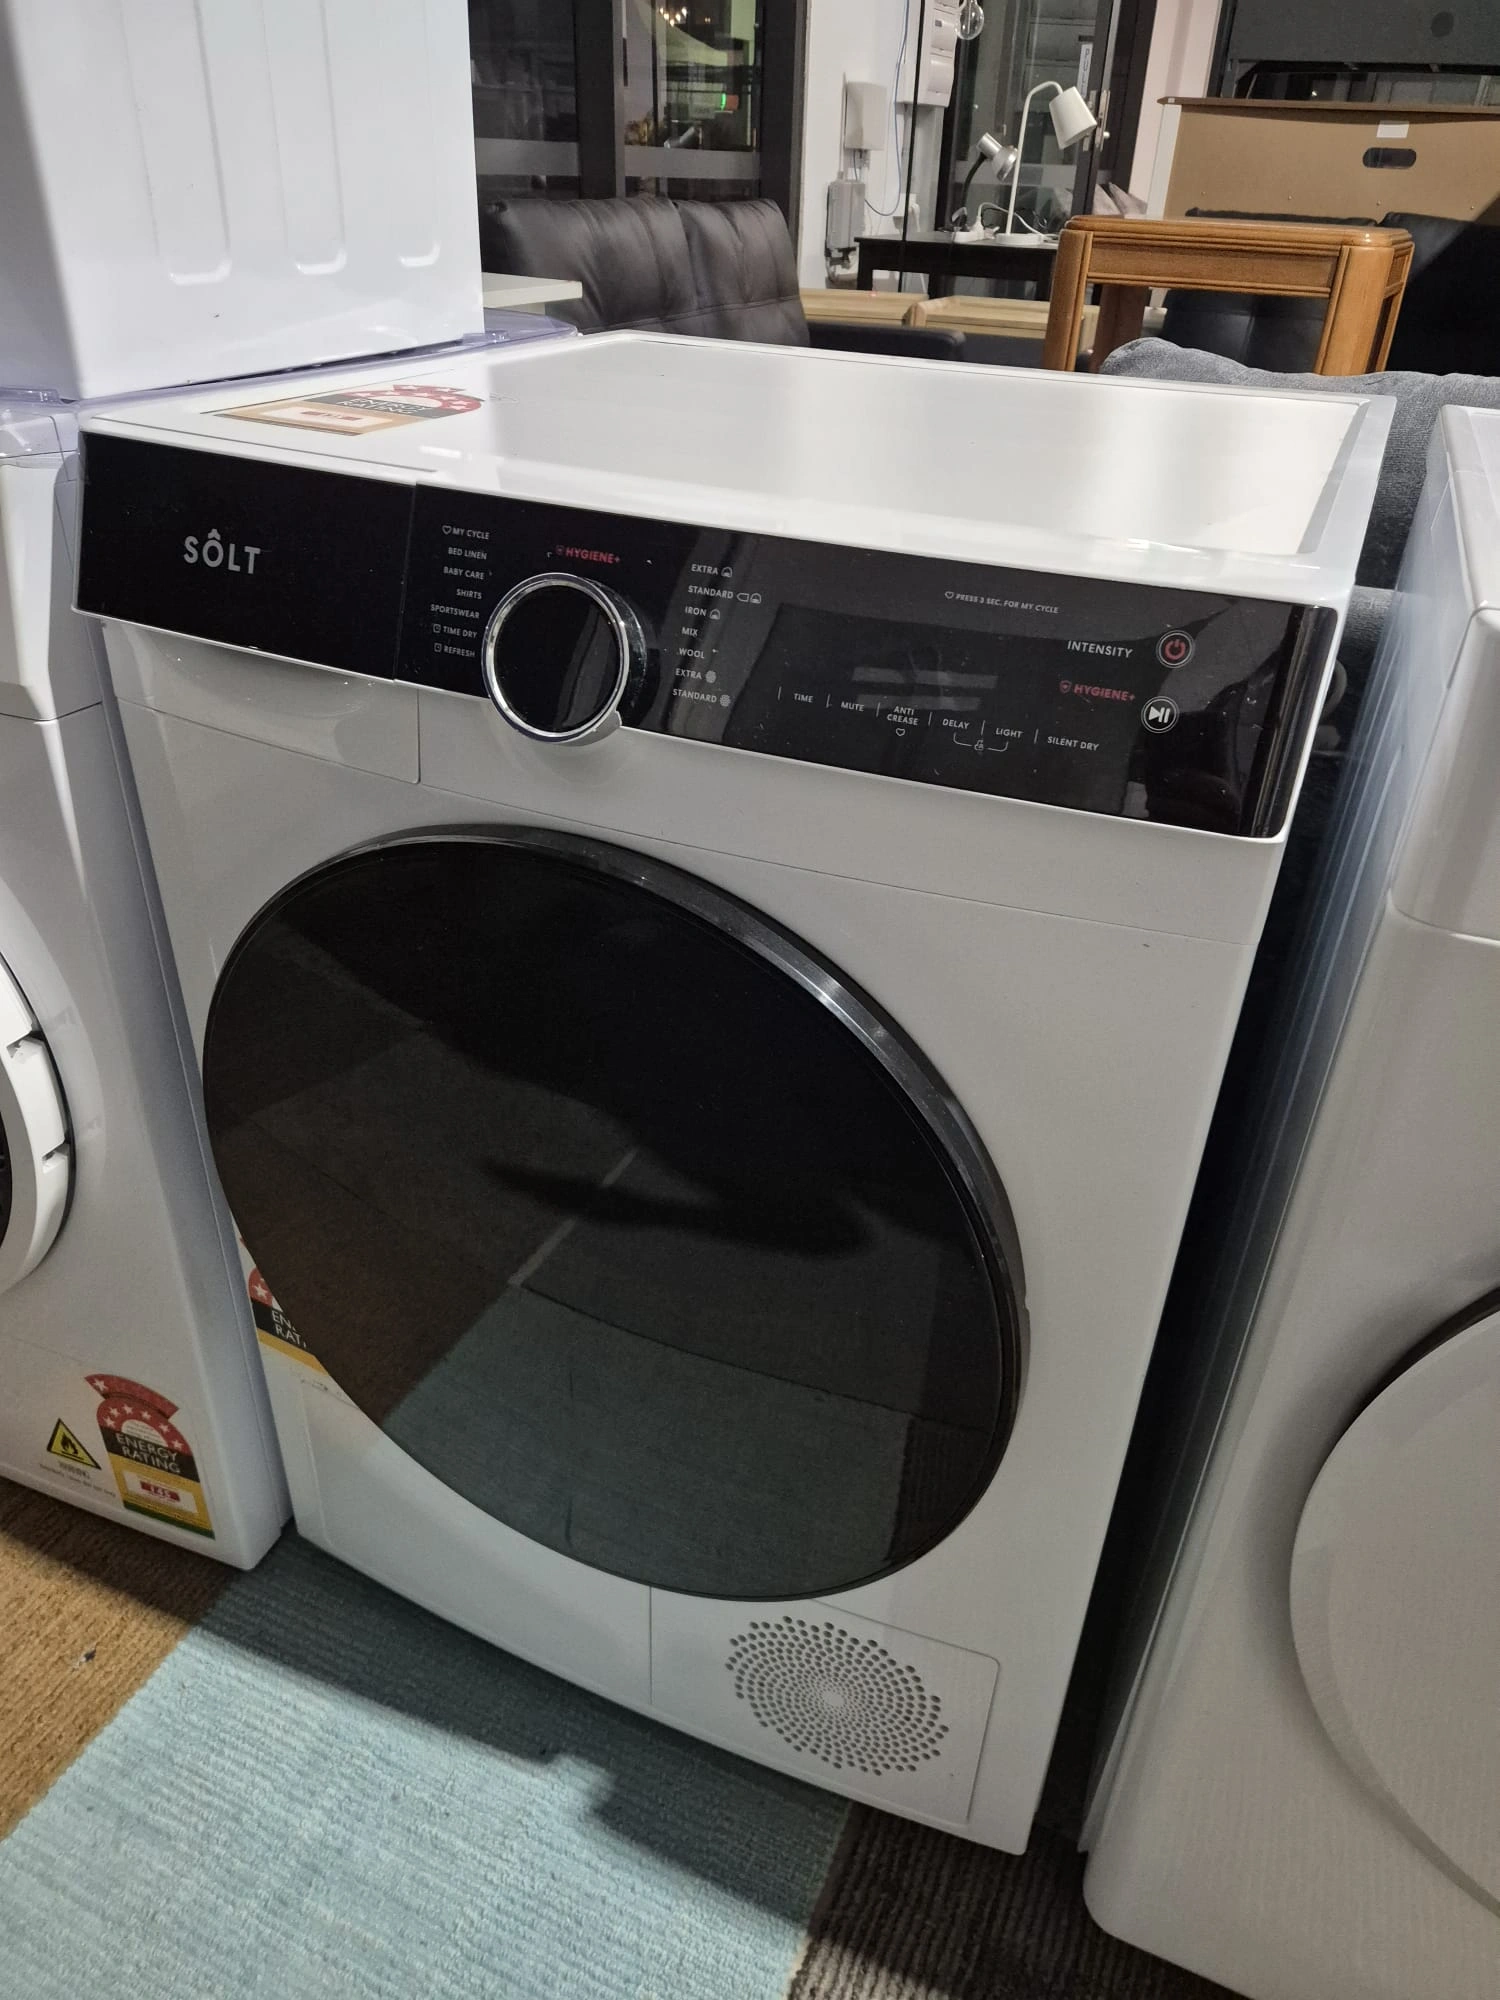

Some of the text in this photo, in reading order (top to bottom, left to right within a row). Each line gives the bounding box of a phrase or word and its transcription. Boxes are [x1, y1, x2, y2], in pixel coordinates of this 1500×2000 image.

[452, 527, 490, 540] MY CYCLE
[183, 528, 261, 575] SÔLT
[447, 546, 488, 560] BED LINEN
[565, 547, 620, 564] HYGIENE+
[443, 566, 485, 580] BABY CARE
[691, 563, 719, 576] EXTRA
[456, 588, 482, 600] SHIRTS
[687, 585, 734, 599] STANDARD
[955, 593, 978, 603] PRESS
[1003, 600, 1019, 608] FOR
[1020, 602, 1034, 610] MY
[1034, 604, 1059, 614] CYCLE
[430, 603, 480, 619] SPORTSWEAR
[684, 606, 707, 617] IRON
[443, 625, 478, 638] TIME DRY
[681, 626, 699, 637] MIX
[443, 645, 476, 658] REFRESH
[679, 648, 705, 659] WOOL
[1067, 640, 1133, 658] INTENSITY
[675, 667, 702, 680] EXTRA
[672, 688, 718, 703] STANDARD
[794, 693, 814, 703] TIME
[1073, 683, 1135, 702] HYGIENE+
[840, 701, 865, 712] MUTE
[893, 705, 915, 716] ANTI
[886, 713, 919, 726] CREASE
[942, 718, 970, 730] DELAY
[995, 727, 1024, 739] LIGHT
[1047, 735, 1100, 752] SILENT DRY
[115, 1431, 178, 1463] ENERGY
[121, 1445, 182, 1474] RATING
